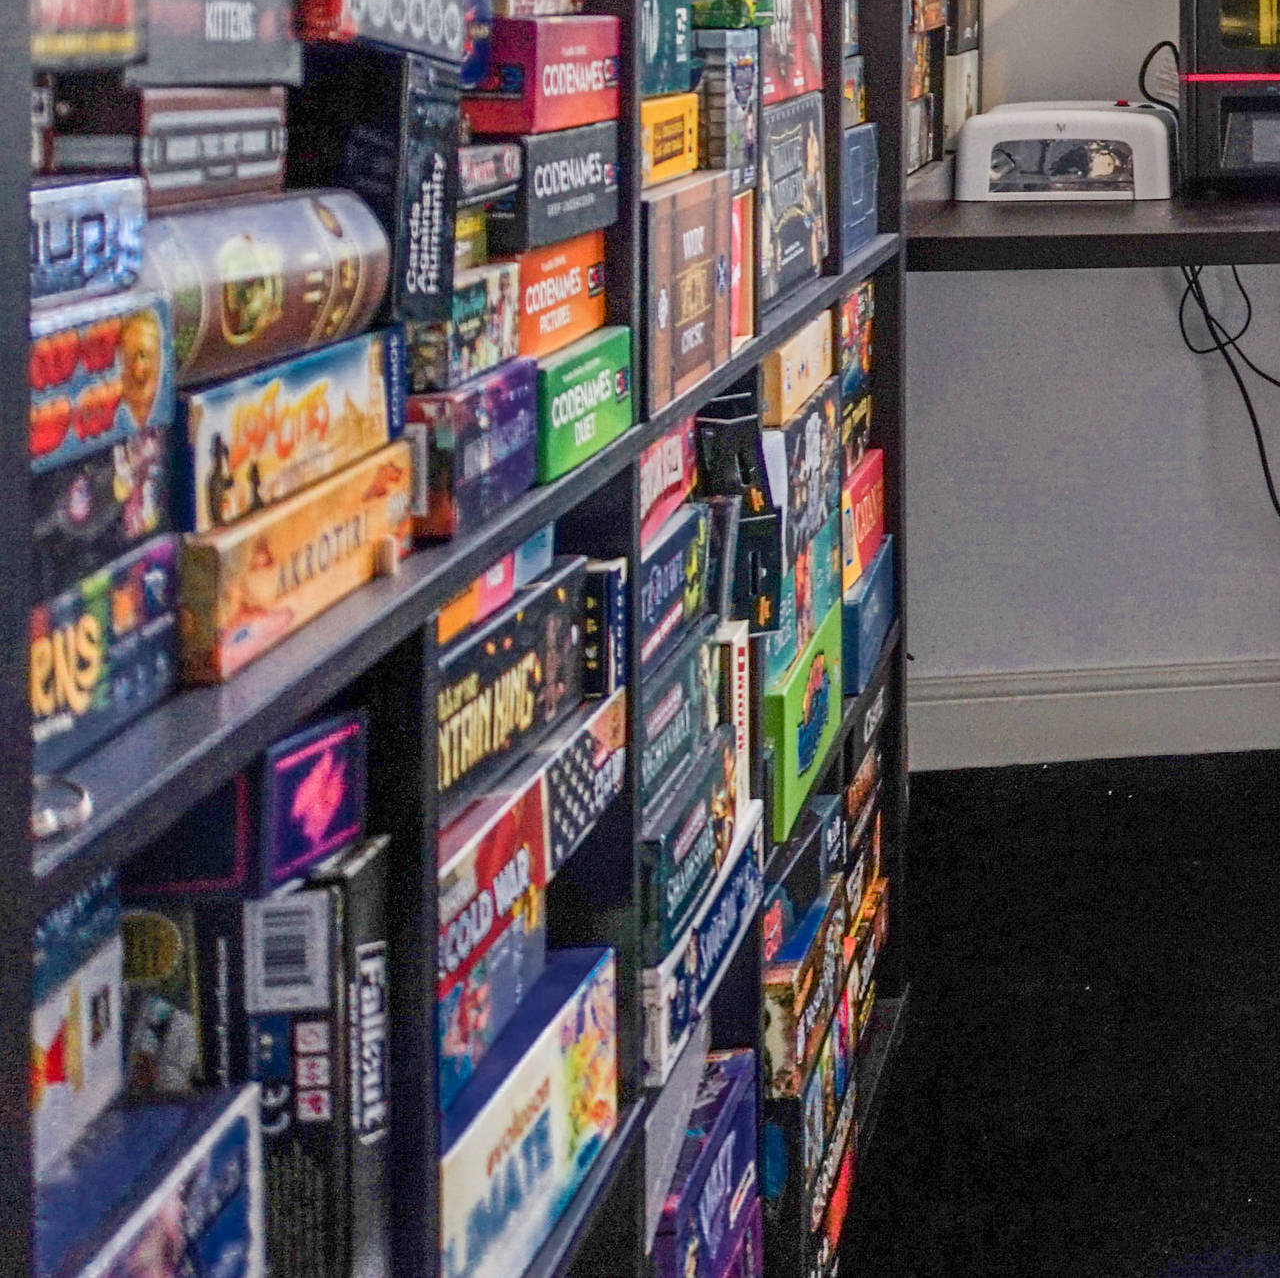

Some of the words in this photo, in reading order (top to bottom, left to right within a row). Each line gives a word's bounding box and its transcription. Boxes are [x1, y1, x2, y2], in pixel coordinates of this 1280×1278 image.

[205, 0, 255, 42] KITTENS
[542, 59, 605, 97] CODENAMES
[534, 151, 602, 199] CODENAMES
[405, 202, 421, 294] Cards
[417, 180, 432, 295] Against
[429, 152, 446, 295] Humanity
[525, 266, 582, 315] CODENAMES
[551, 368, 612, 429] CODENAMES
[573, 413, 597, 447] DUET
[446, 887, 495, 975] COLD
[493, 847, 532, 917] WAR
